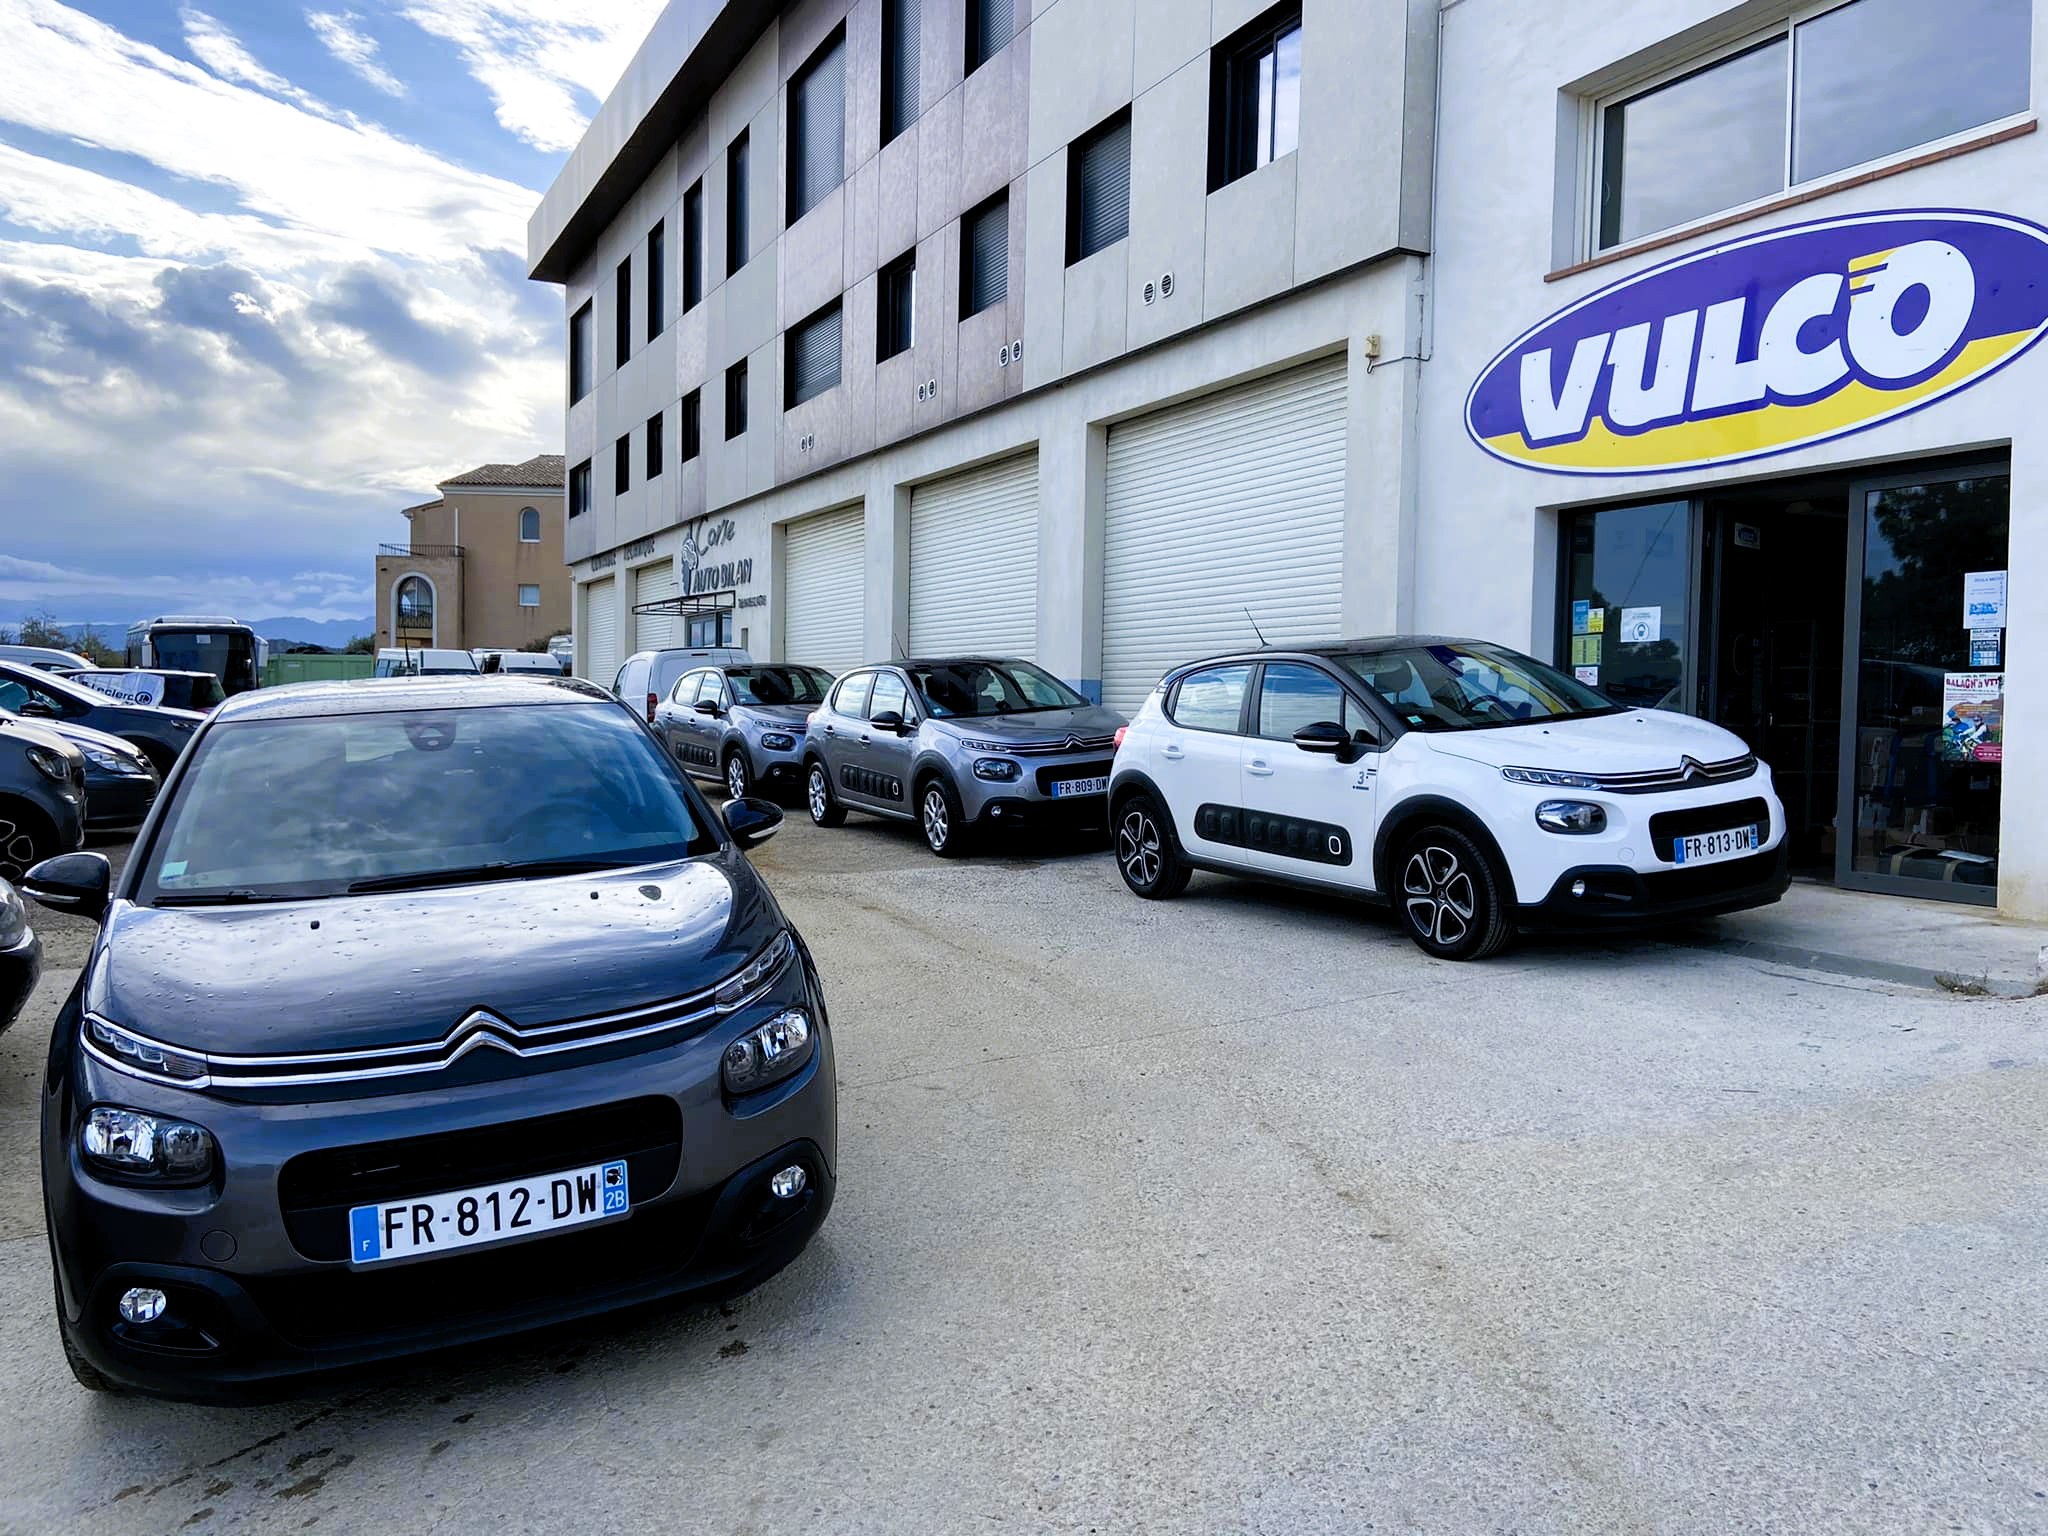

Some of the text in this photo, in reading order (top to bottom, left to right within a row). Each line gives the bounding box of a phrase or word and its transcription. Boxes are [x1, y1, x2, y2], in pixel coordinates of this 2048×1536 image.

[1520, 240, 1976, 441] VULCO
[692, 557, 753, 594] AUTO BILAN
[1684, 828, 1750, 859] FR-813-DW
[362, 1172, 625, 1252] F FR-812-DW 2B
